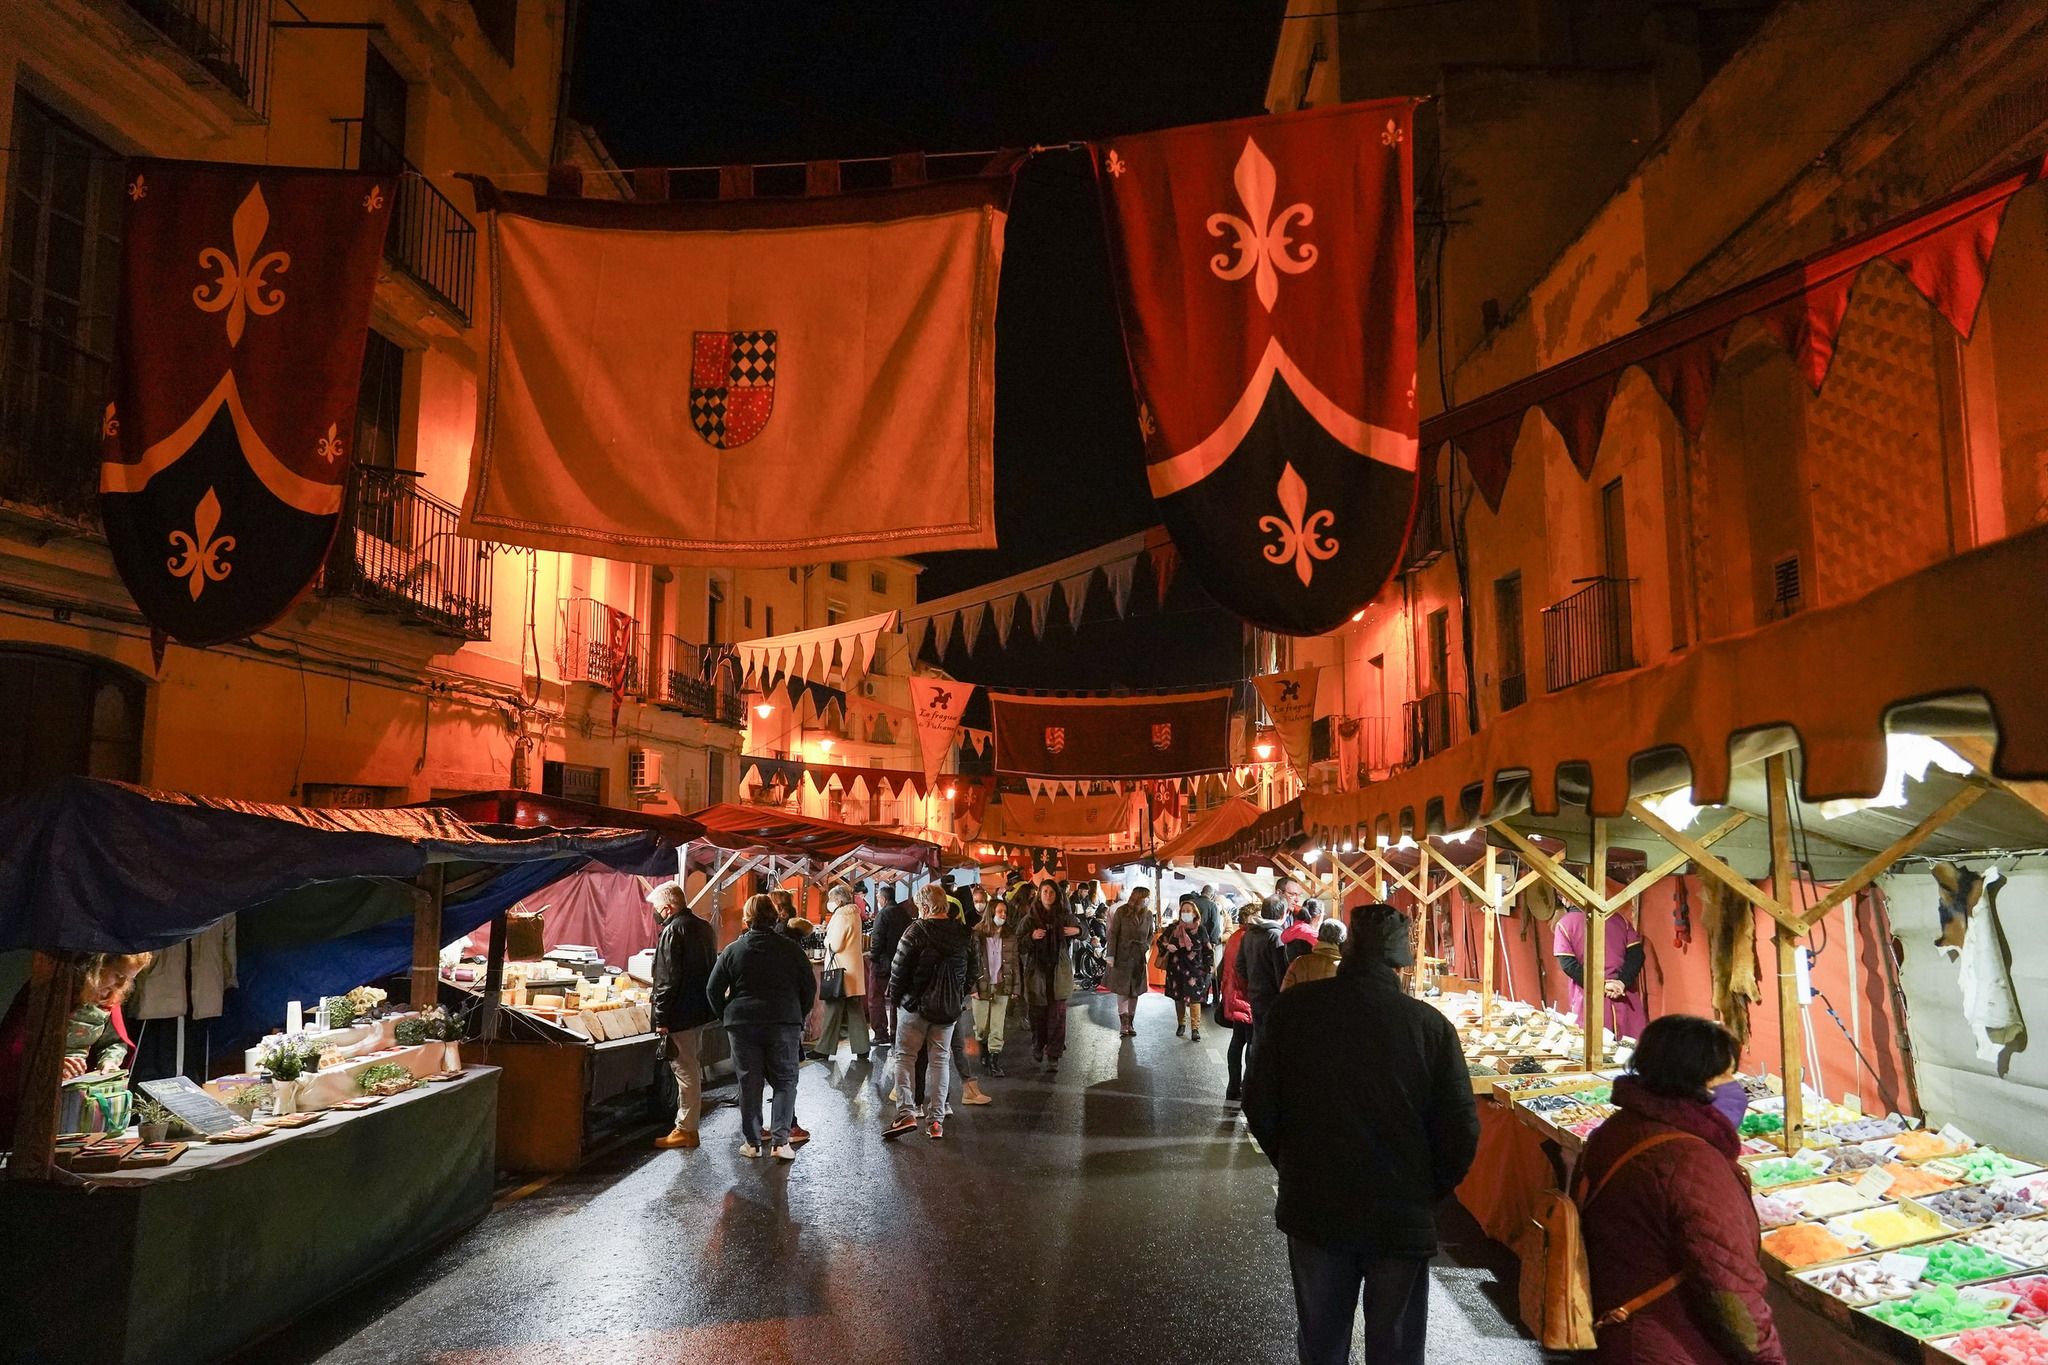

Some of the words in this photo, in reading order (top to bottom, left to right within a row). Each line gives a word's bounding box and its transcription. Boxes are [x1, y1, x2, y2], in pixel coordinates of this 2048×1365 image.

[919, 708, 930, 718] La
[930, 710, 958, 723] fragua
[1926, 1162, 1958, 1176] Mango
